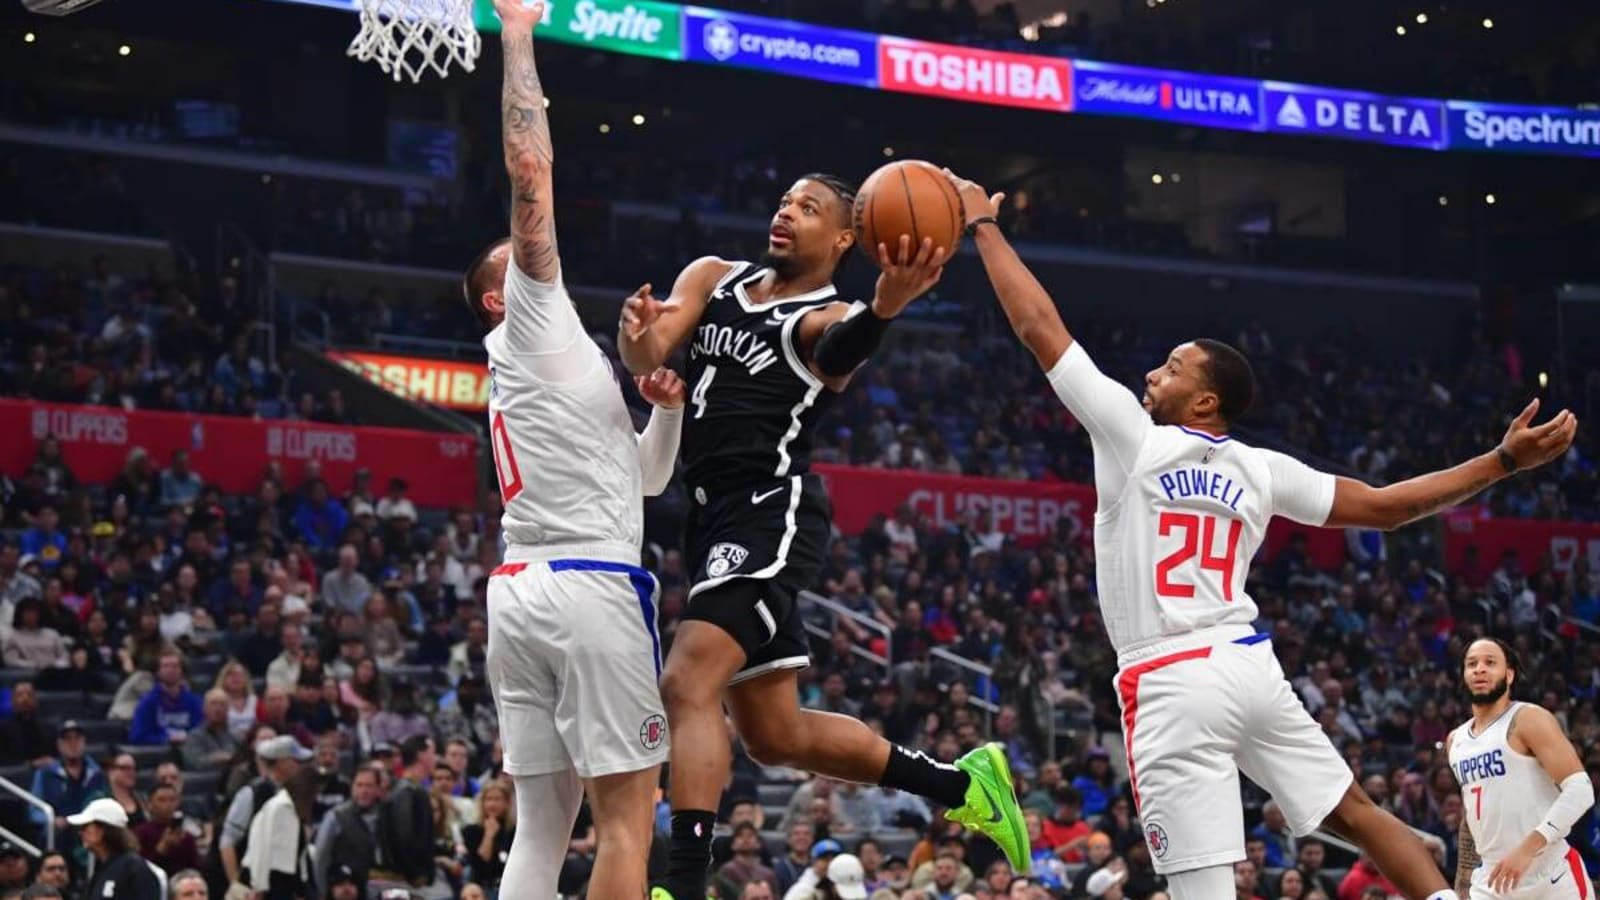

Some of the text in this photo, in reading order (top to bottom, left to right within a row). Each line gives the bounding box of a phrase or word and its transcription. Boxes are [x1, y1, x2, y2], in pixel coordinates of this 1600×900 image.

[569, 0, 663, 42] Sprite
[739, 33, 860, 67] crypto.com
[887, 47, 1064, 102] TOSHIBA
[1174, 86, 1253, 116] ULTRA
[1315, 98, 1431, 138] DELTA
[691, 364, 717, 418] 4
[52, 409, 128, 444] CLIPPERS
[285, 427, 355, 463] CLIPPERS
[1160, 468, 1244, 512] POWELL
[711, 543, 746, 564] NETS
[1156, 511, 1243, 603] 24
[1470, 785, 1482, 821] 7
